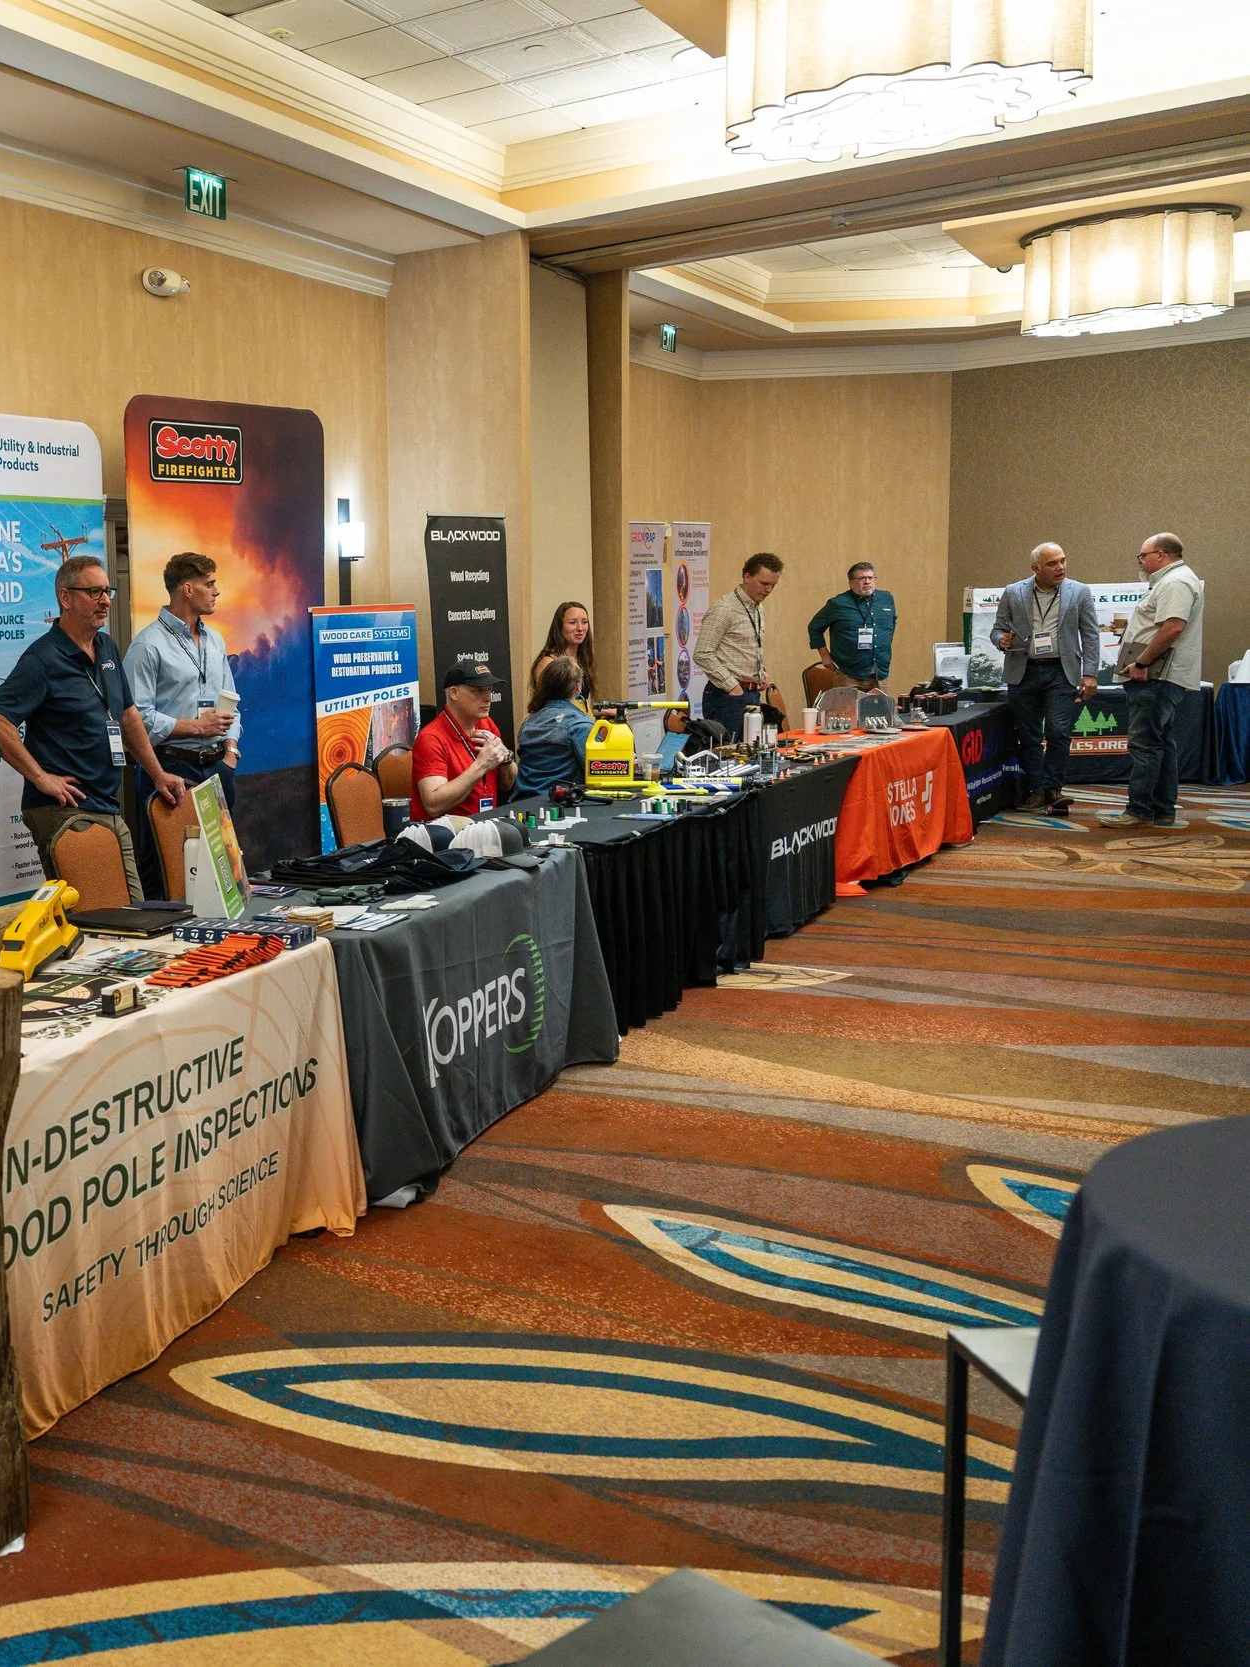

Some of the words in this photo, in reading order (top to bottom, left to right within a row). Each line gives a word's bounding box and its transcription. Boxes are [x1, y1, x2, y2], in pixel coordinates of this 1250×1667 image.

[189, 174, 223, 217] EXIT
[28, 441, 35, 453] &
[36, 441, 80, 457] Industrial
[155, 426, 237, 466] Scotty
[157, 463, 237, 479] FIREFIGHTER
[430, 530, 501, 543] BLACKWOOD
[450, 570, 464, 582] Wood
[465, 569, 490, 583] Recycling
[1099, 595, 1109, 603] &
[447, 610, 471, 622] Concrete
[471, 608, 496, 621] Recycling
[0, 630, 25, 641] POLES
[322, 631, 349, 641] WOOD
[349, 630, 372, 640] CARE
[373, 628, 409, 639] SYSTEMS
[333, 653, 352, 664] WOOD
[353, 652, 393, 663] PRESERVATIVE
[474, 651, 489, 662] Racks
[331, 665, 371, 678] RESTORATION
[371, 663, 403, 675] PRODUCTS
[324, 695, 370, 713] UTILITY
[373, 686, 411, 703] POLES
[590, 761, 628, 771] Scotty
[887, 776, 917, 804] STELLA
[14, 860, 31, 869] Faster
[15, 869, 43, 879] alternative
[422, 967, 526, 1089] KOPPERS
[82, 1140, 166, 1225] POLE
[173, 1057, 319, 1174] INSPECTIONS
[42, 1246, 127, 1325] SAFETY
[134, 1196, 215, 1269] THROUGH
[216, 1150, 280, 1212] SCIENCE
